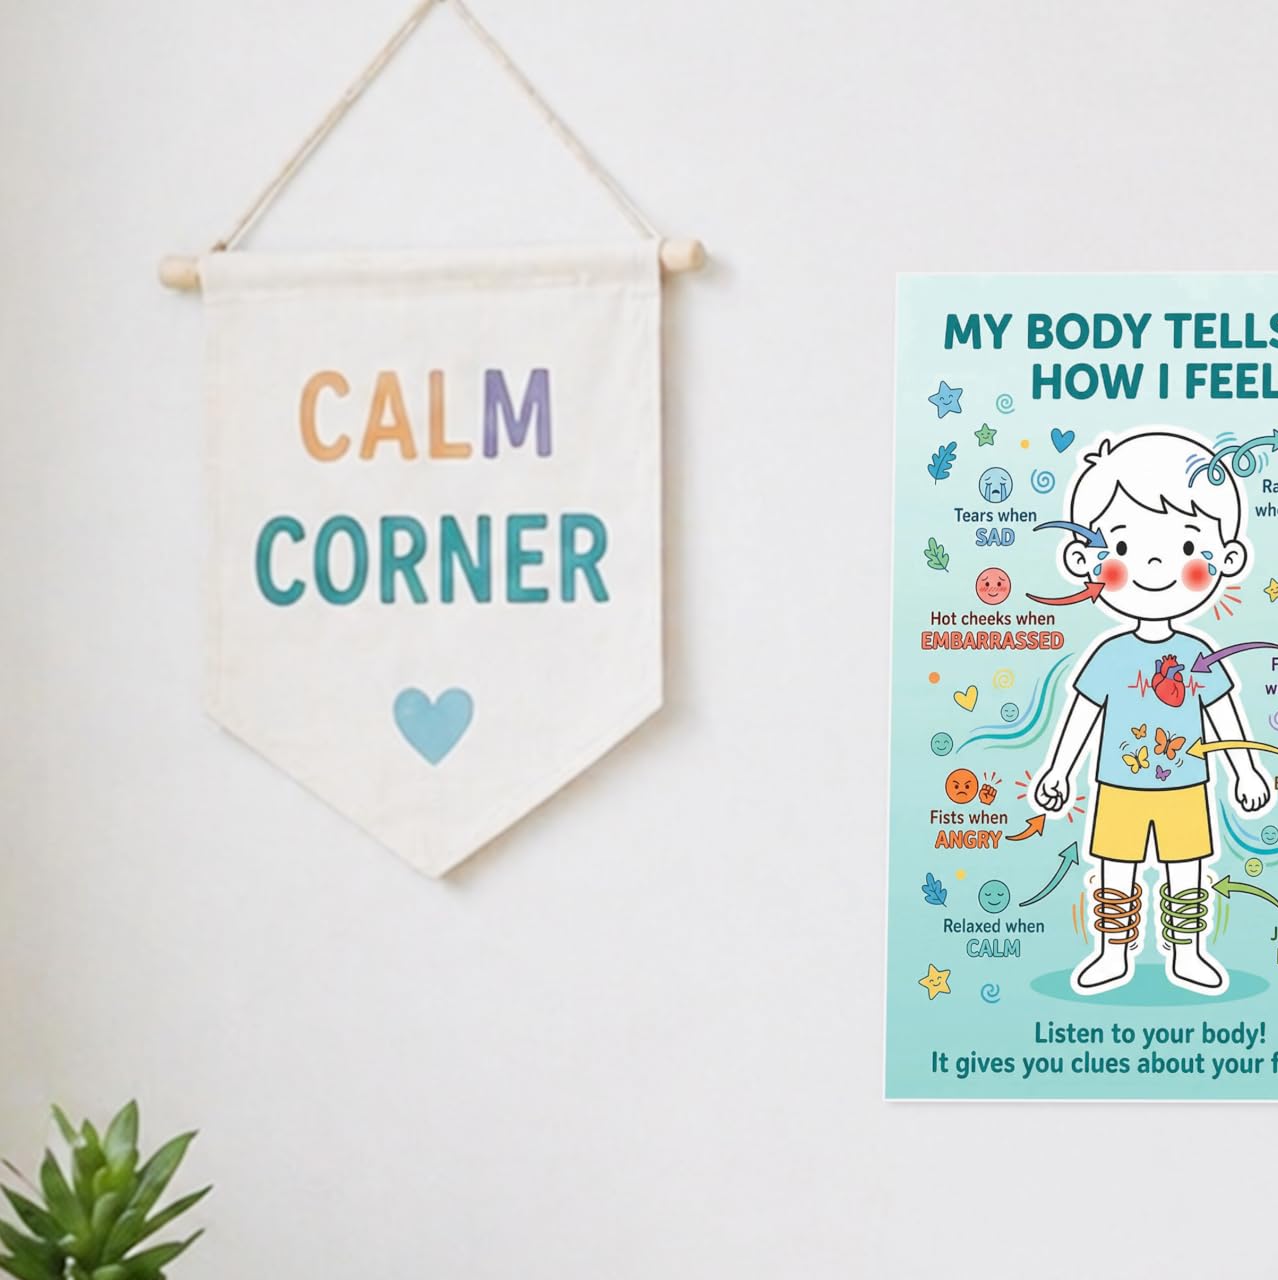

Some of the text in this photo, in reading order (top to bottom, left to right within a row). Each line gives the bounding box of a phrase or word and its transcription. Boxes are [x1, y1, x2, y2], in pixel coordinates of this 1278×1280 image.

[944, 314, 1012, 349] MY
[1028, 313, 1152, 350] BODY
[1033, 363, 1144, 400] HOW
[1160, 363, 1168, 399] I
[300, 368, 552, 461] CALM
[954, 508, 1036, 522] Tears when
[976, 528, 1015, 546] SAD
[255, 513, 609, 606] CORNER
[932, 611, 1054, 625] Hot cheeks when
[921, 631, 1064, 650] EMBARRASSED
[931, 810, 1007, 824] Fists when
[935, 830, 1002, 849] ANGRY
[944, 918, 1044, 933] Relaxed when
[967, 939, 1020, 957] CALM
[1036, 1021, 1265, 1050] Listen to your body!
[933, 1051, 948, 1072] It
[956, 1051, 1015, 1079] gives
[1023, 1057, 1063, 1079] you
[1072, 1051, 1130, 1073] clues
[1138, 1051, 1204, 1073] about
[1212, 1057, 1264, 1079] your
